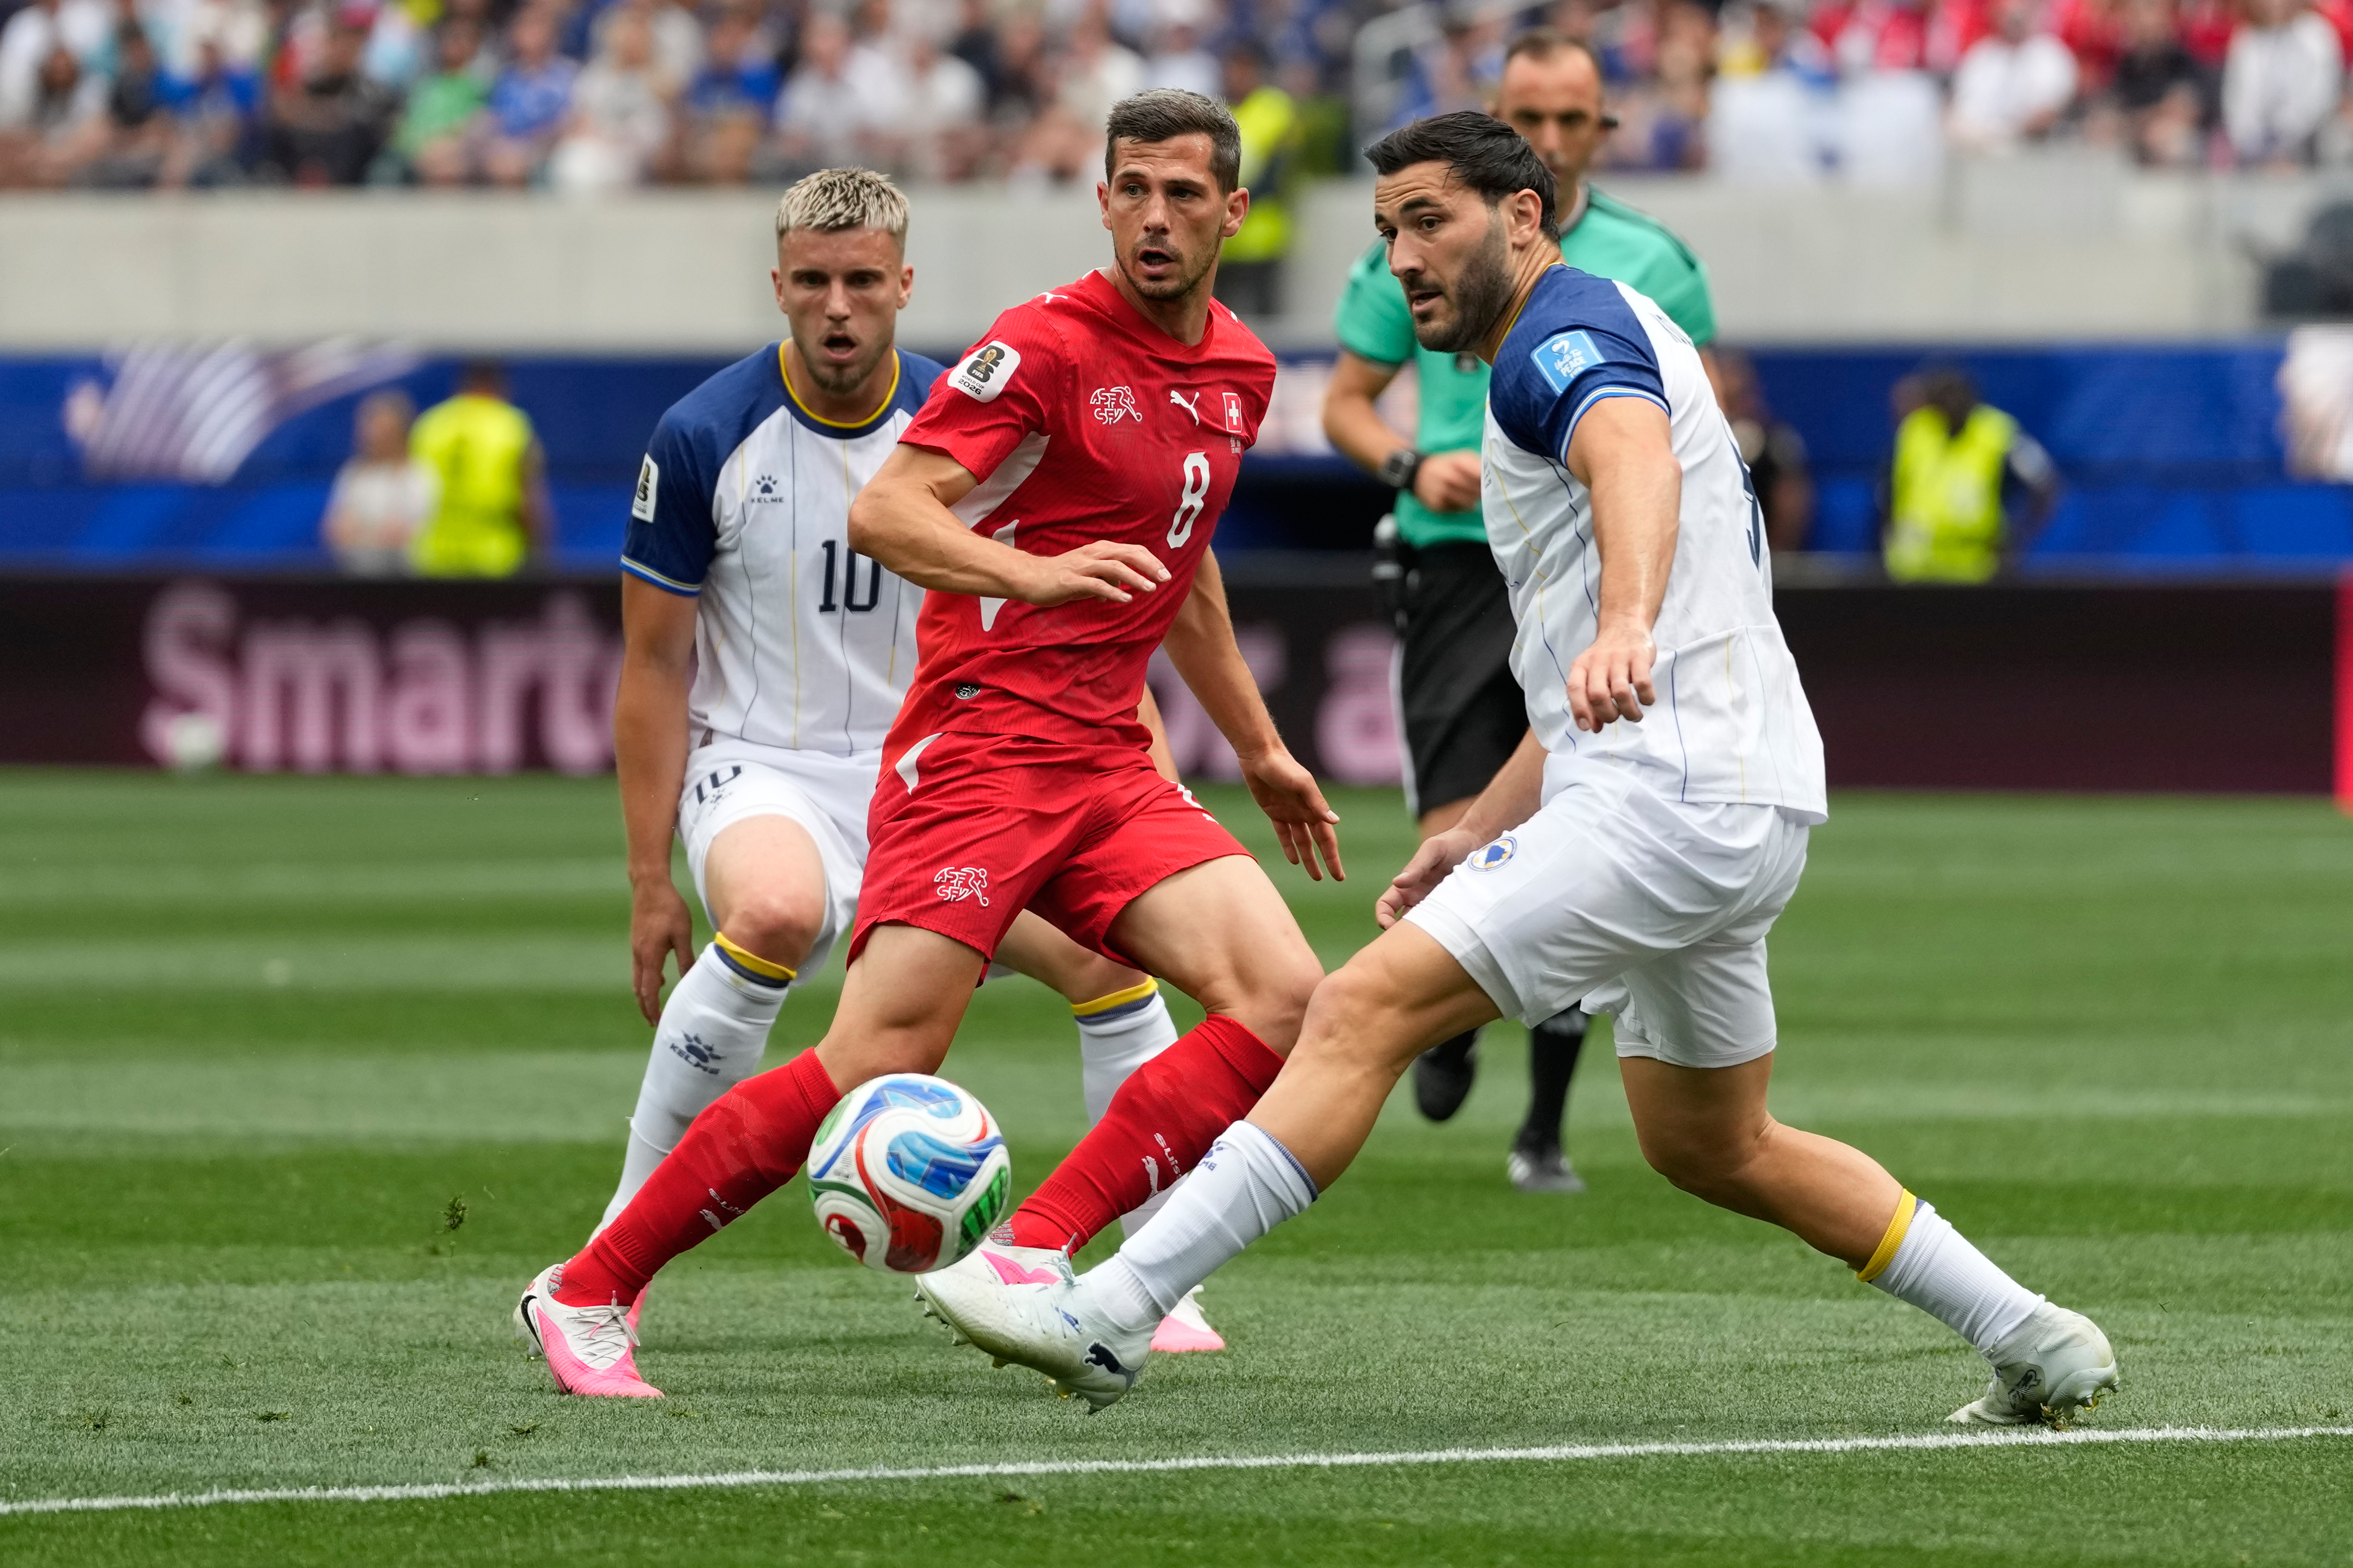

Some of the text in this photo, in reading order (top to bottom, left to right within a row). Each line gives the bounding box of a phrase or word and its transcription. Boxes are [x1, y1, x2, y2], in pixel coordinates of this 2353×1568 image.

[971, 369, 984, 379] FIFA
[1560, 356, 1587, 377] PEACE
[957, 378, 982, 396] 2026
[961, 374, 976, 385] WORLD
[1166, 451, 1210, 549] 8
[819, 539, 884, 613] 10
[141, 579, 623, 774] Smart
